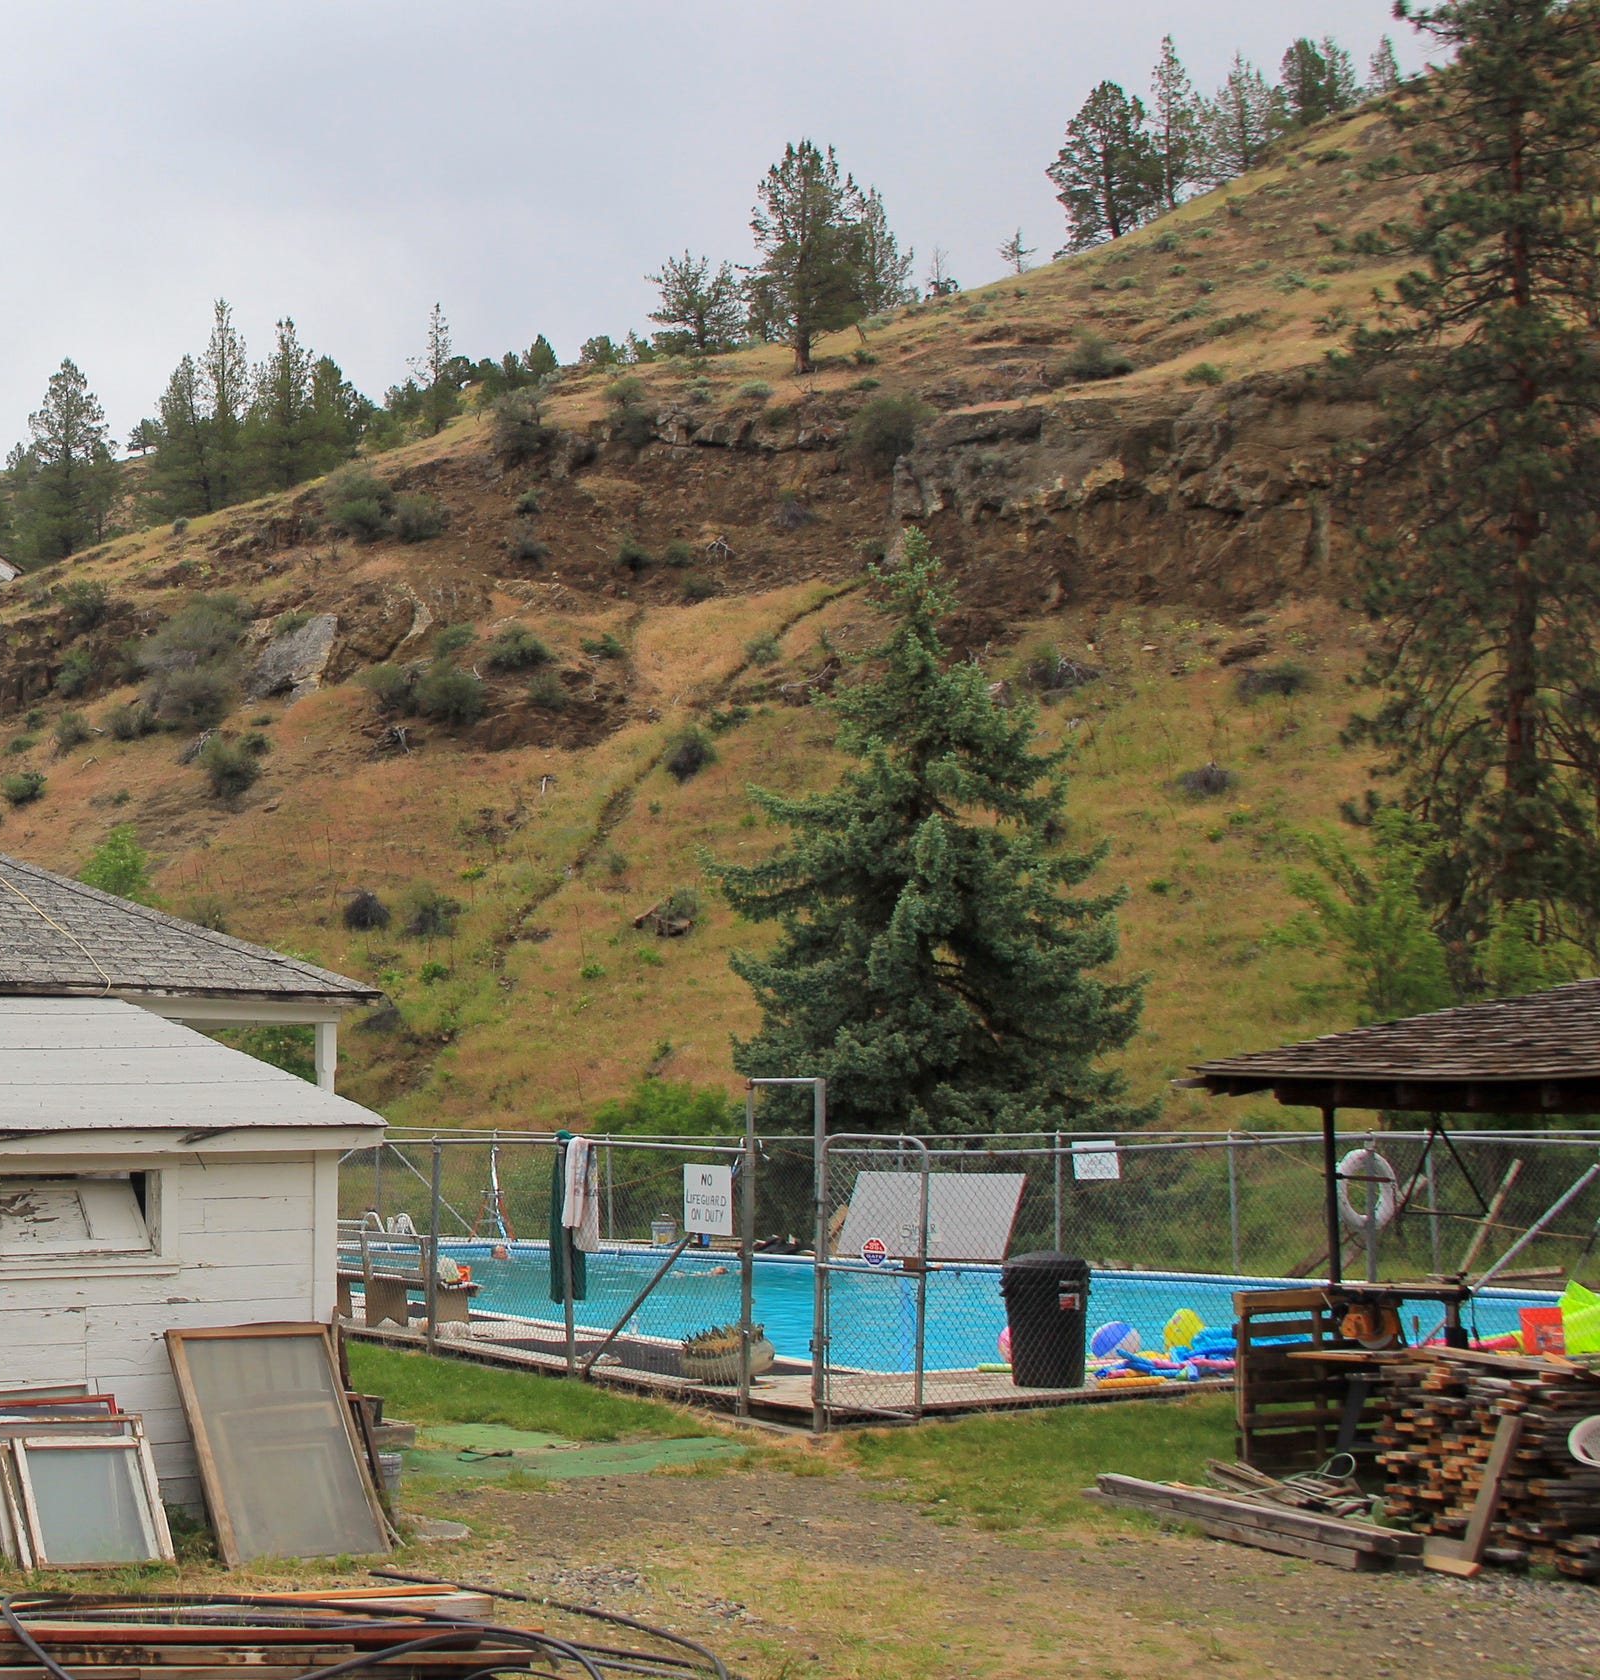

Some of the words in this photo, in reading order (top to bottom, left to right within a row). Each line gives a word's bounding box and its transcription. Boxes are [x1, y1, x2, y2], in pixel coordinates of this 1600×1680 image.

[701, 1173, 713, 1187] NO
[686, 1189, 727, 1207] LIFEGUARD
[691, 1208, 701, 1220] ON
[705, 1209, 724, 1222] DUTY
